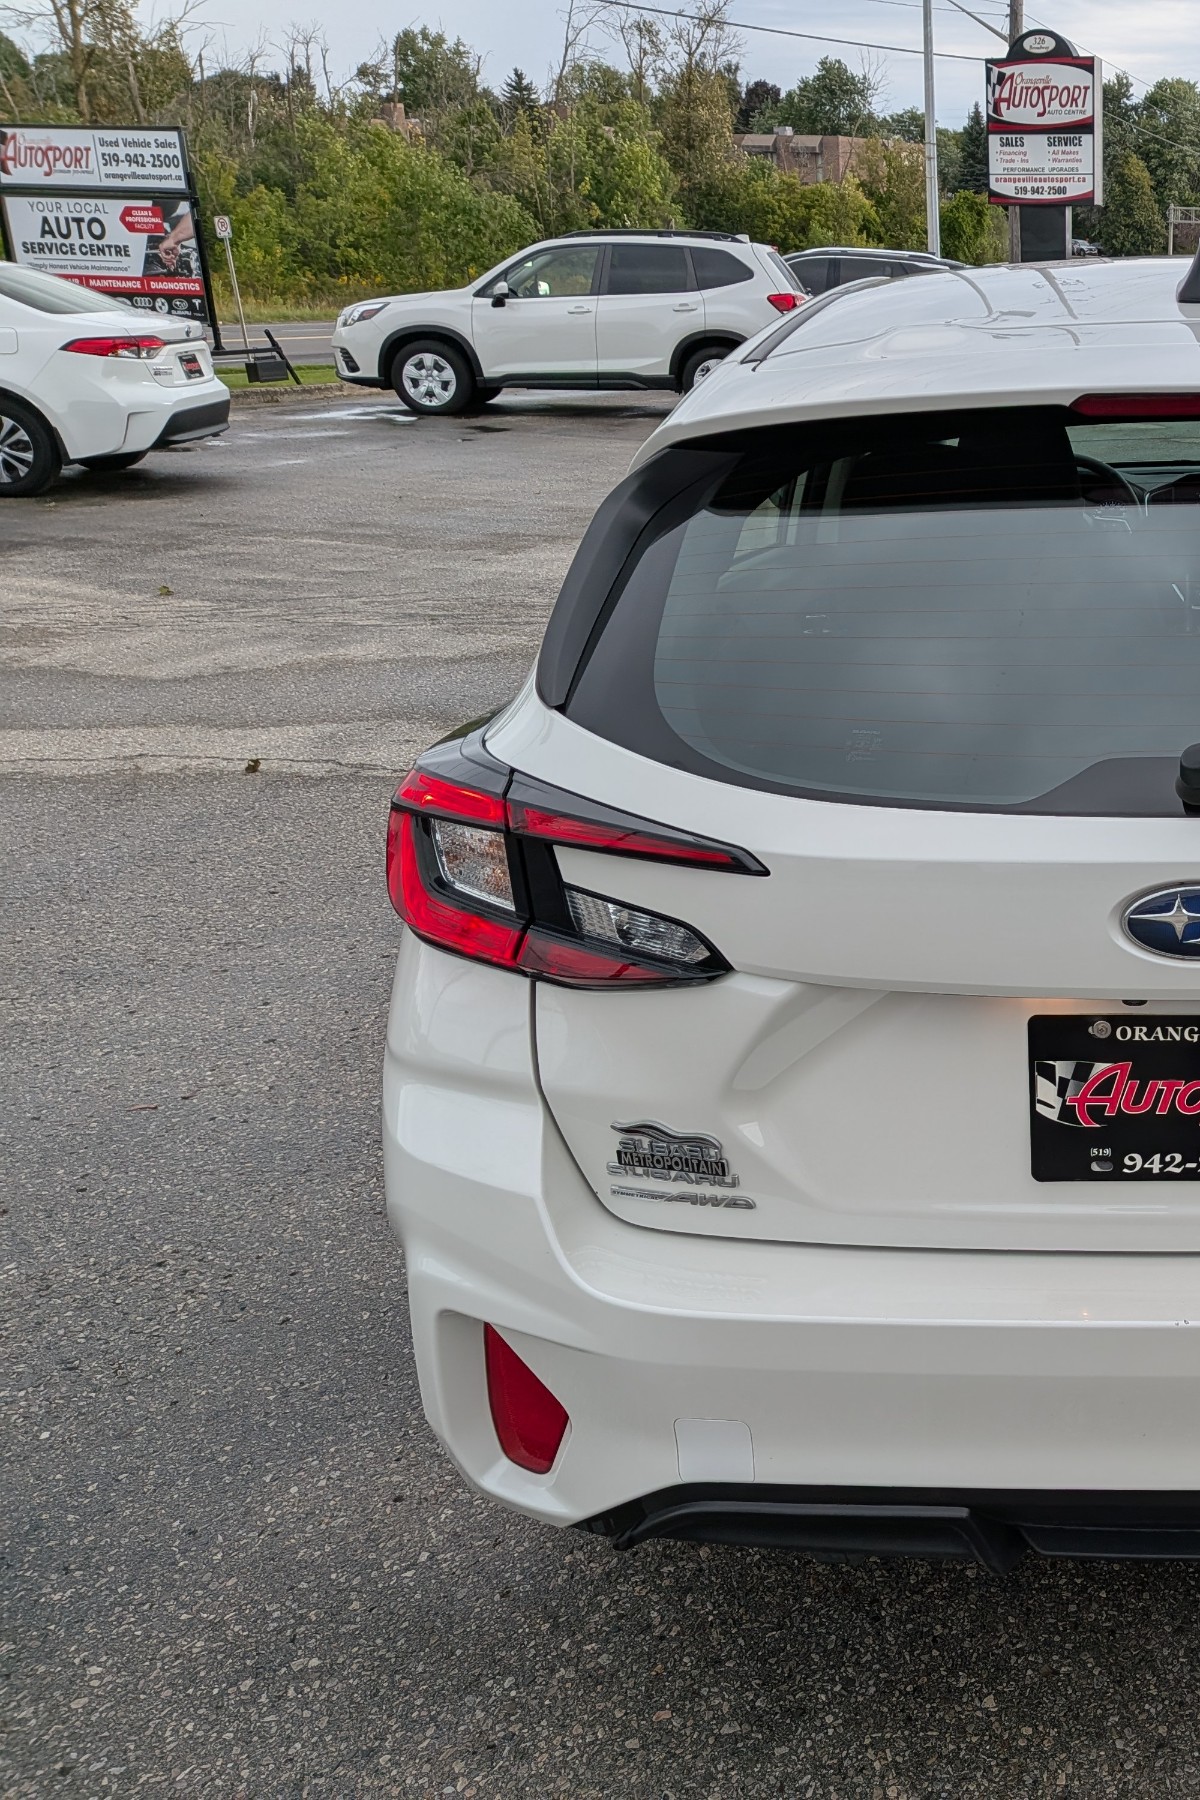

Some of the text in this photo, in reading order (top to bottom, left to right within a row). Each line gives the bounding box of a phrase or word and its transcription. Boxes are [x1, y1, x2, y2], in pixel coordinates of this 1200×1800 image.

[1033, 37, 1046, 45] 326
[98, 137, 177, 149] Used Vehicle Sales
[999, 136, 1025, 147] SALES
[1047, 136, 1083, 147] SERVICE
[101, 152, 180, 168] 519-942-2500
[104, 171, 182, 182] orangevilleautosport.ca
[1014, 186, 1067, 195] 519-942-2500
[28, 201, 109, 214] YOUR LOCAL
[40, 216, 106, 240] AUTO
[22, 241, 131, 257] SERVICE CENTRE
[89, 279, 142, 289] MAINTENANCE
[150, 281, 200, 291] DIAGNOSTICS
[1090, 1148, 1112, 1157] (519)
[621, 1151, 724, 1176] METROPOLITAIN
[611, 1189, 757, 1210] SYMMETRICAL AWD
